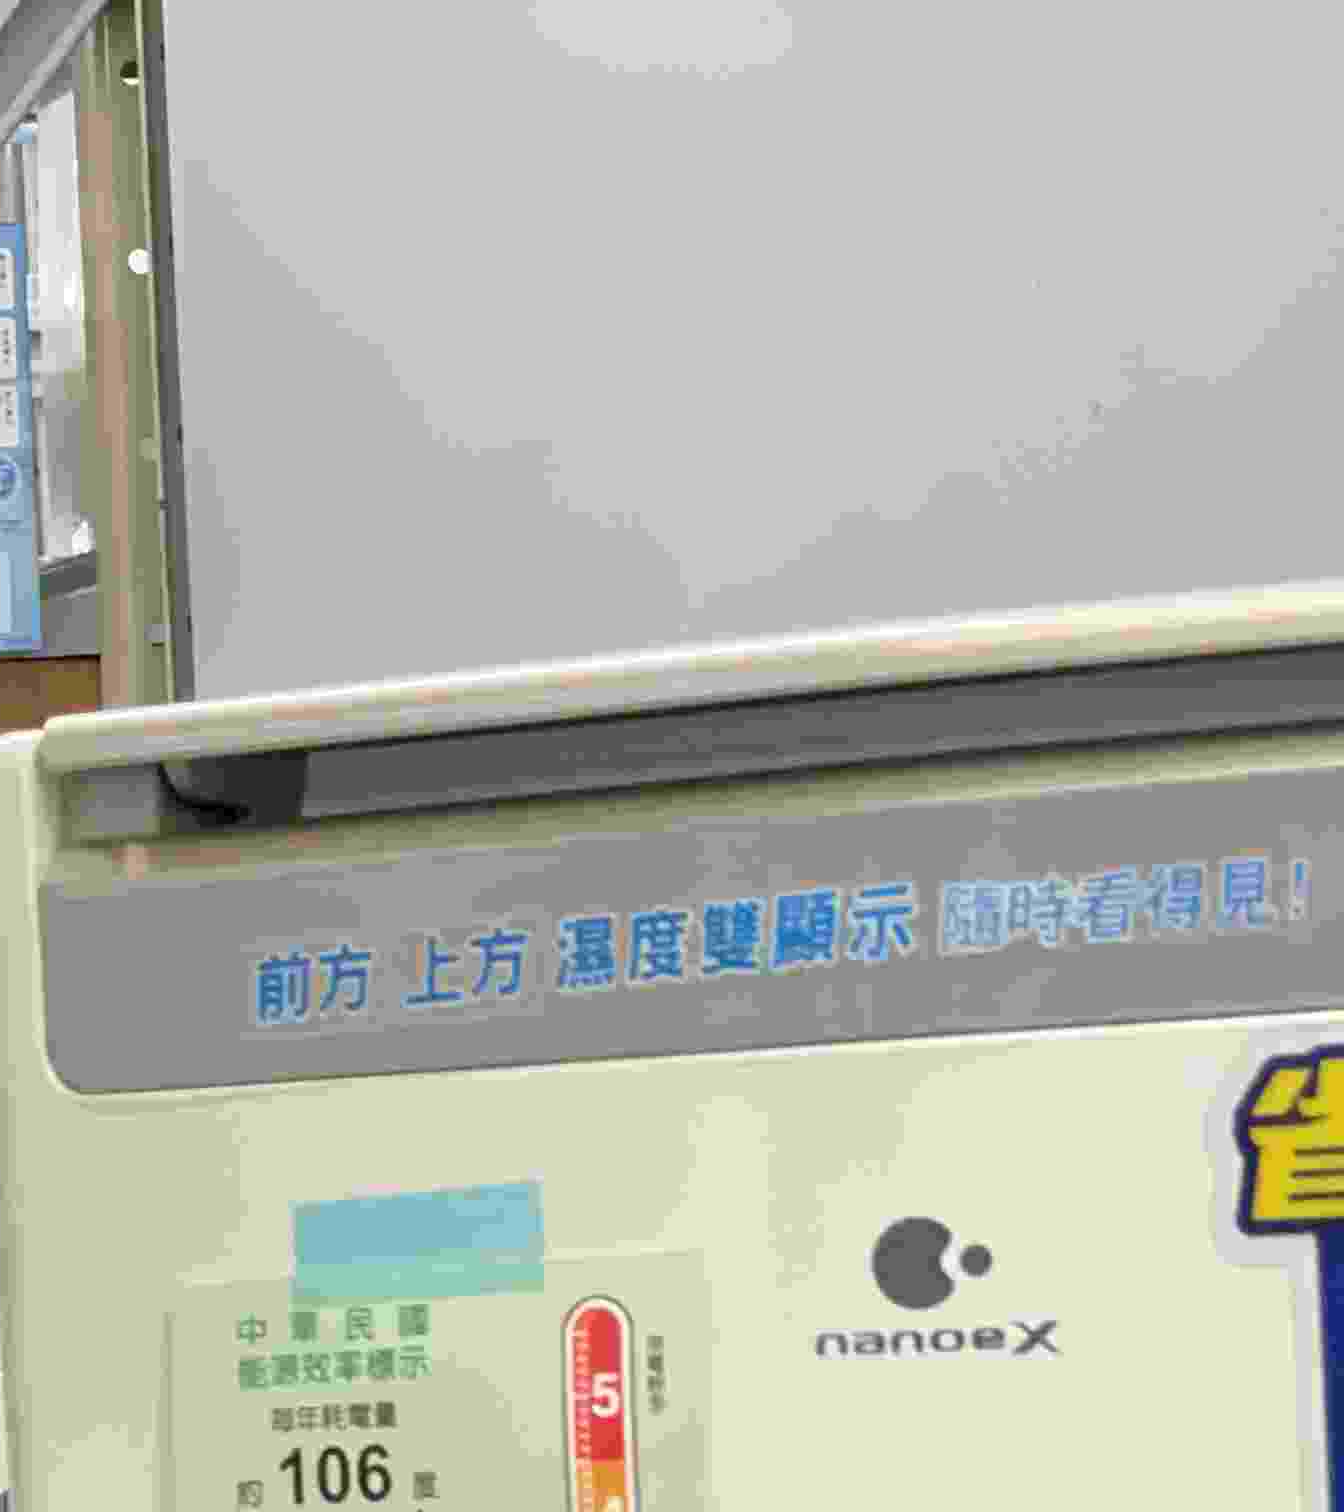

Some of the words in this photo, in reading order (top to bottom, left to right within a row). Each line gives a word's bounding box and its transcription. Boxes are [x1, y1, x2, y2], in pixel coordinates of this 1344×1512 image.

[255, 944, 372, 1023] 前方
[404, 926, 530, 1005] 上方
[554, 883, 917, 991] 濕度雙顯示
[592, 1372, 619, 1417] 5
[279, 1443, 393, 1506] 106
